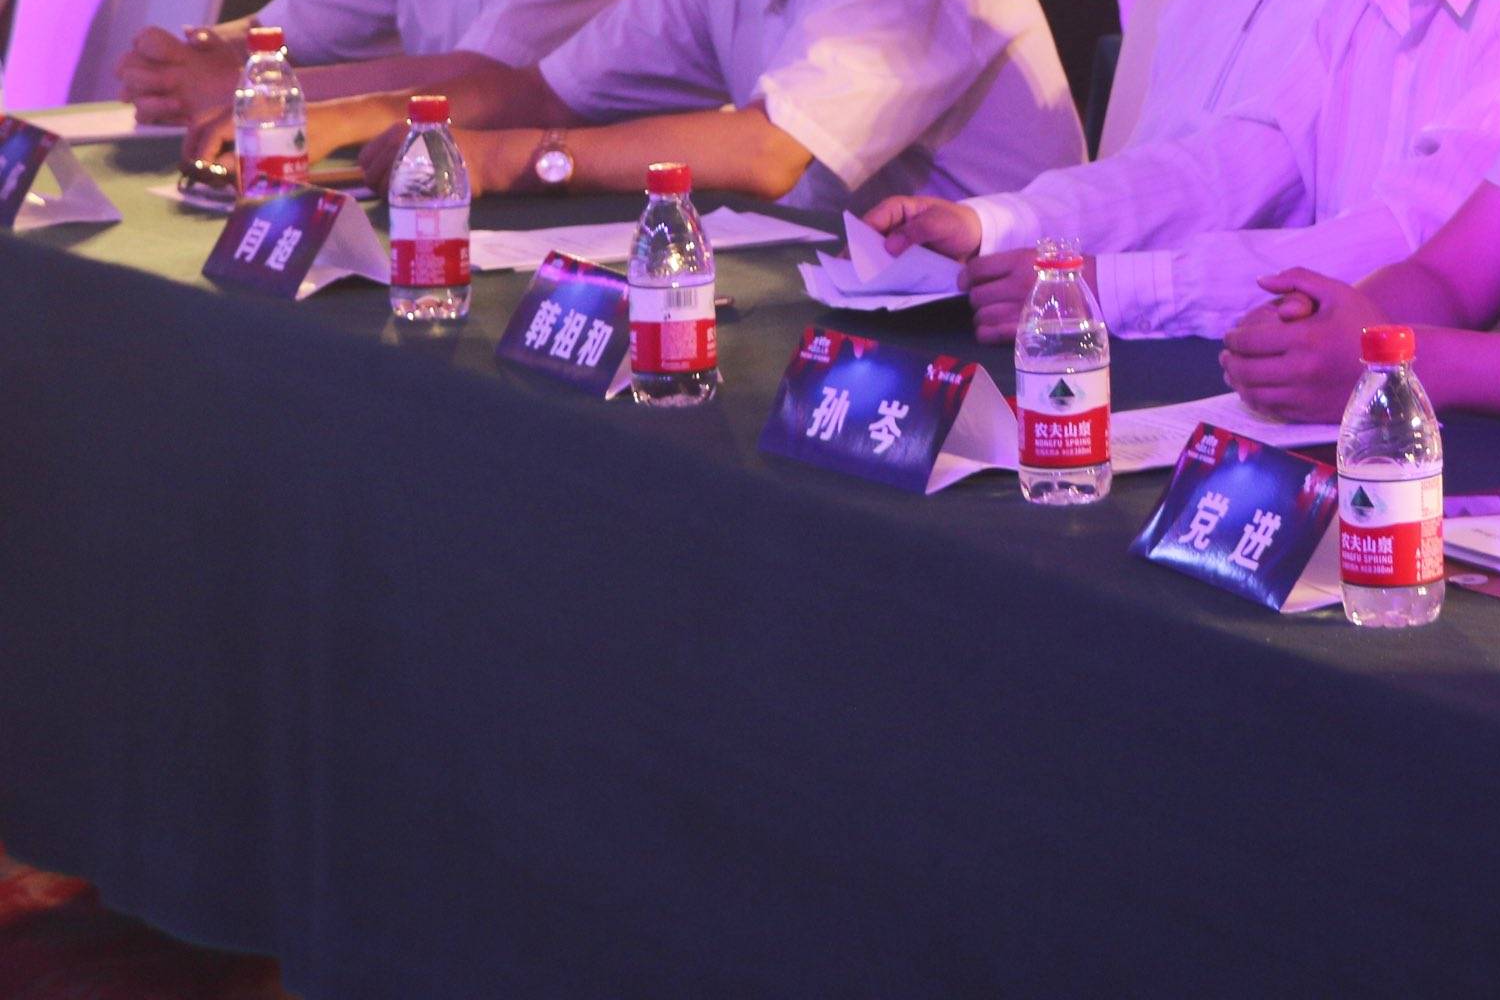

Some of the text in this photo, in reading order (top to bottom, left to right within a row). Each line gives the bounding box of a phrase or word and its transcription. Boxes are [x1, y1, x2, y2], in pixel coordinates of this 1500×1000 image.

[524, 299, 614, 368] 韩祖和
[805, 386, 910, 455] 孙岑
[1035, 421, 1092, 438] 农夫山泉
[1178, 491, 1282, 572] 党进
[1341, 532, 1393, 554] 农夫山泉
